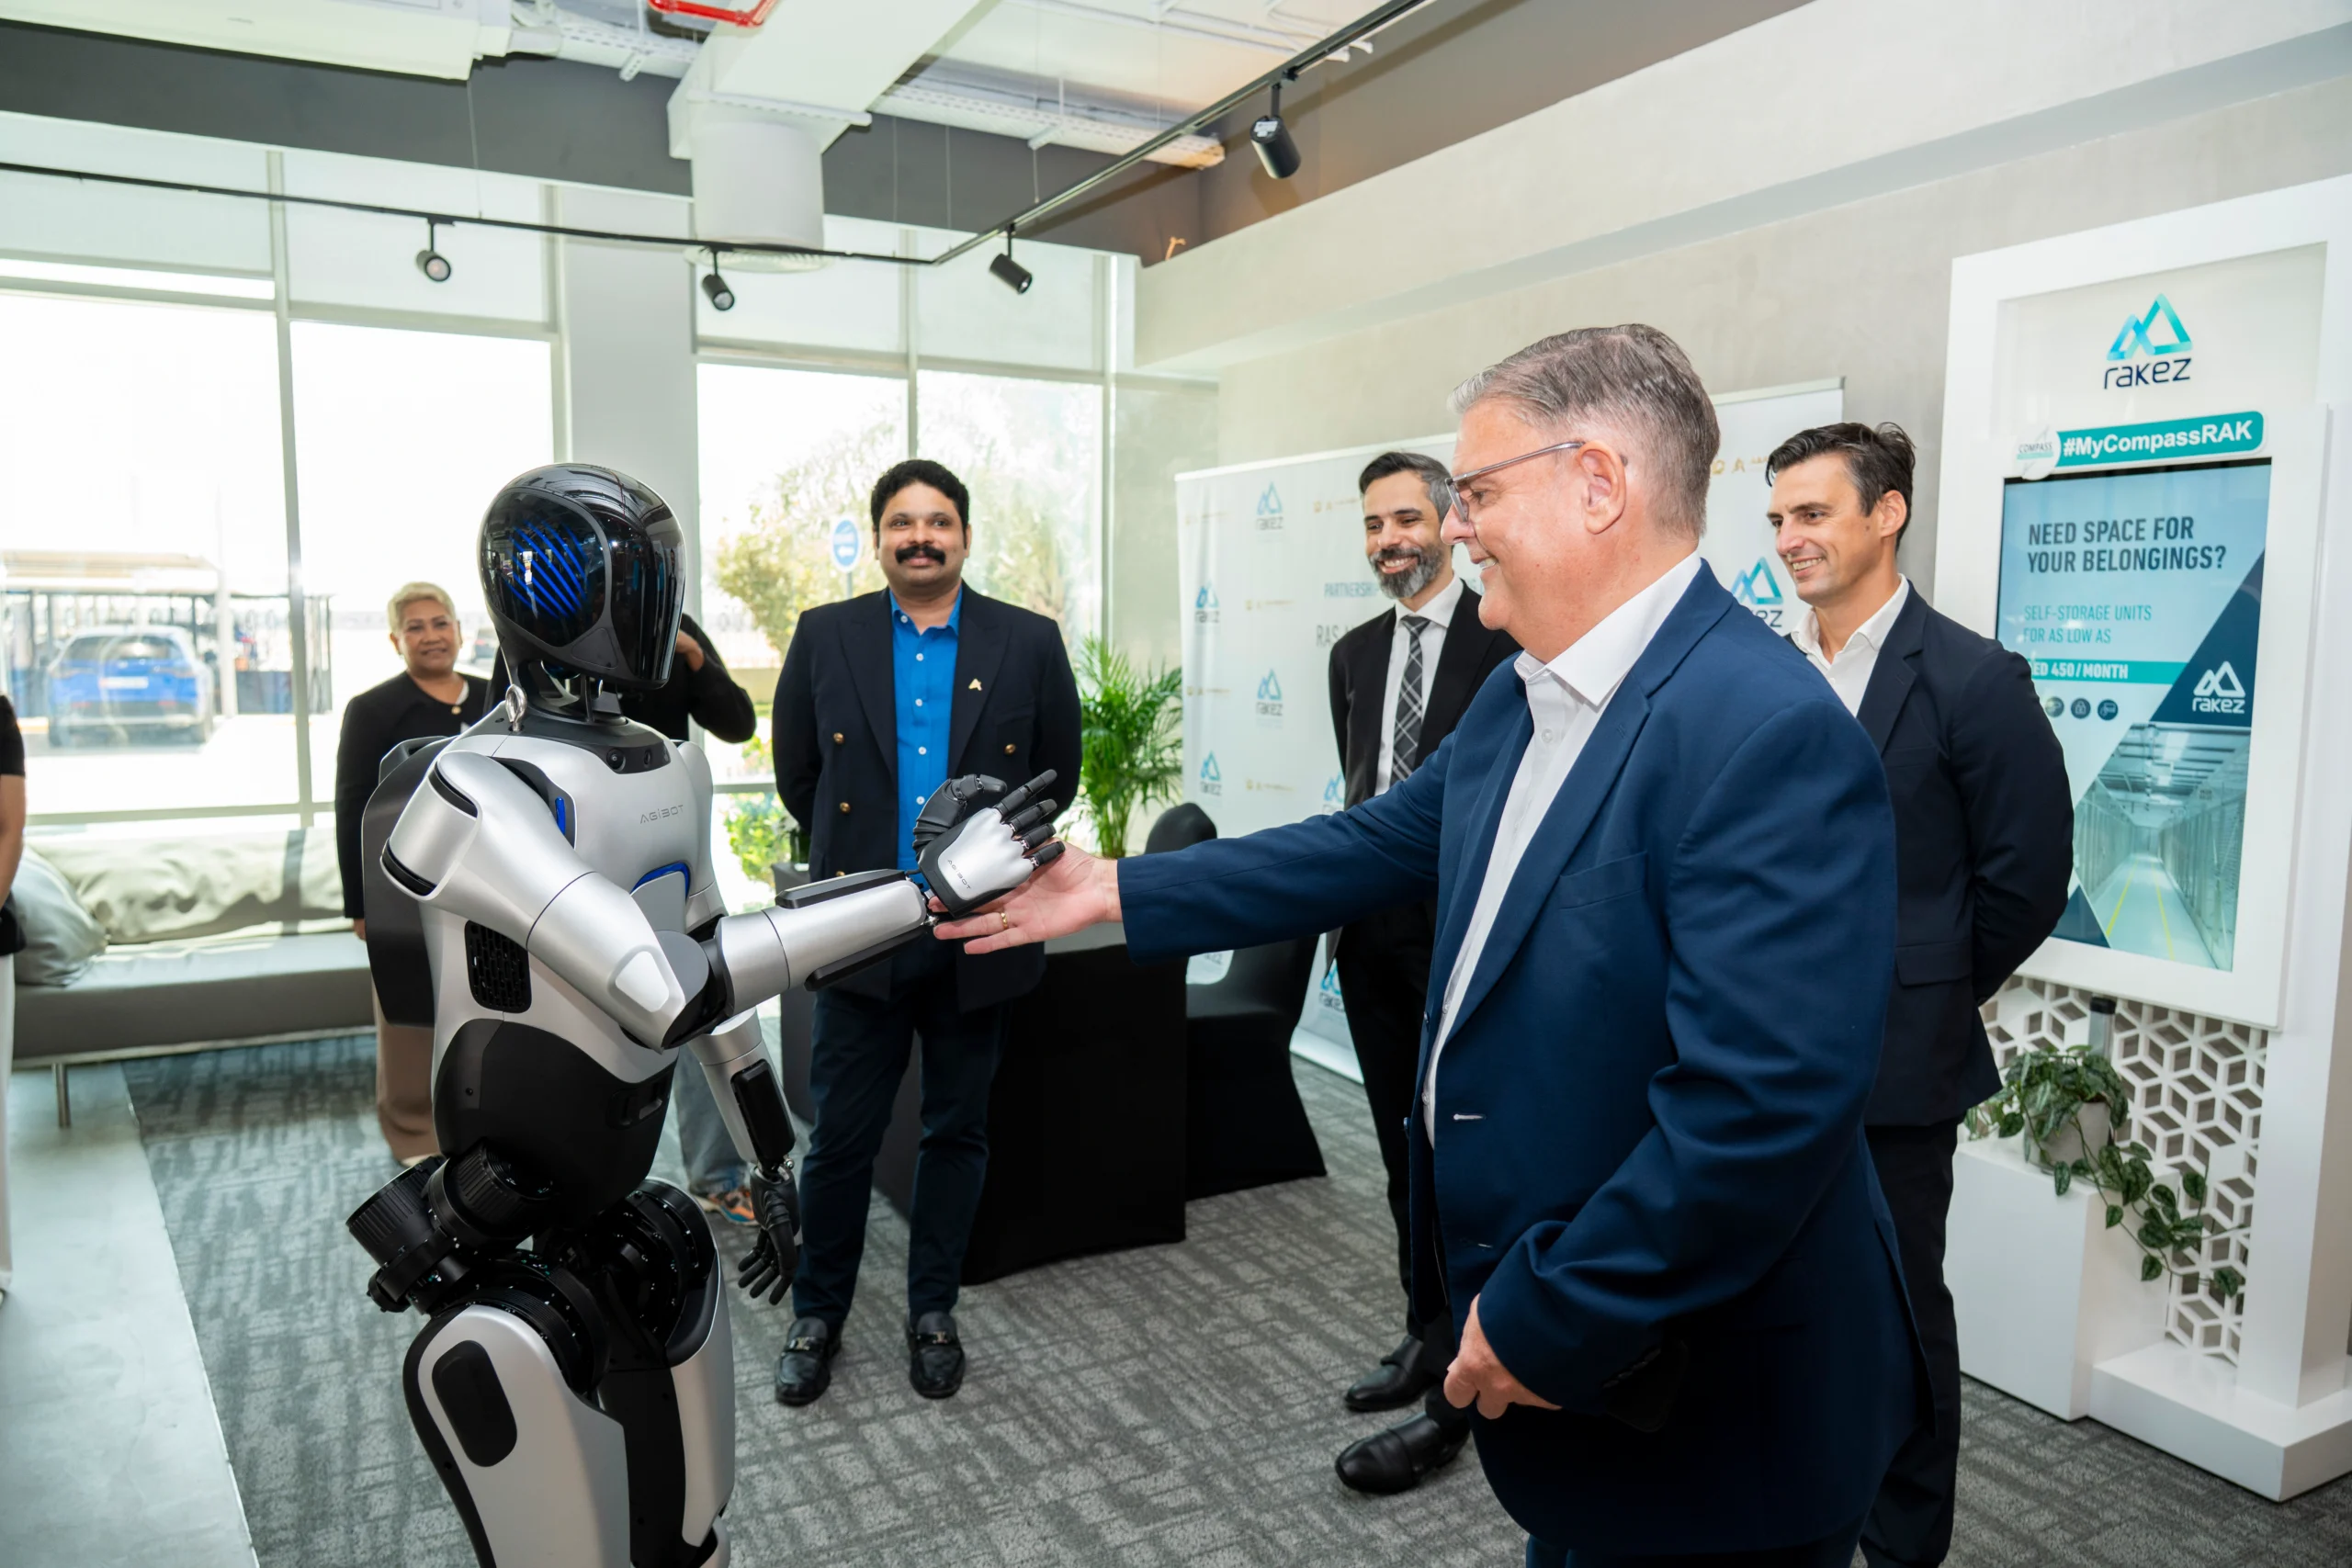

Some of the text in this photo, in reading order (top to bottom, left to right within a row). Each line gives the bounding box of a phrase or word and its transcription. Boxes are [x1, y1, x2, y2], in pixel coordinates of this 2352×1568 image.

[2104, 358, 2191, 389] rakez
[2064, 420, 2253, 459] #MyCompassRAK
[2028, 516, 2194, 546] NEED SPACE FOR
[2027, 545, 2227, 573] YOUR BELONGINGS?
[1194, 610, 1219, 624] raz
[2024, 604, 2152, 621] SELF-STORAGE UNITS
[2023, 628, 2111, 644] FOR AS LOW AS
[2030, 660, 2049, 677] ED
[2192, 696, 2245, 714] rakez
